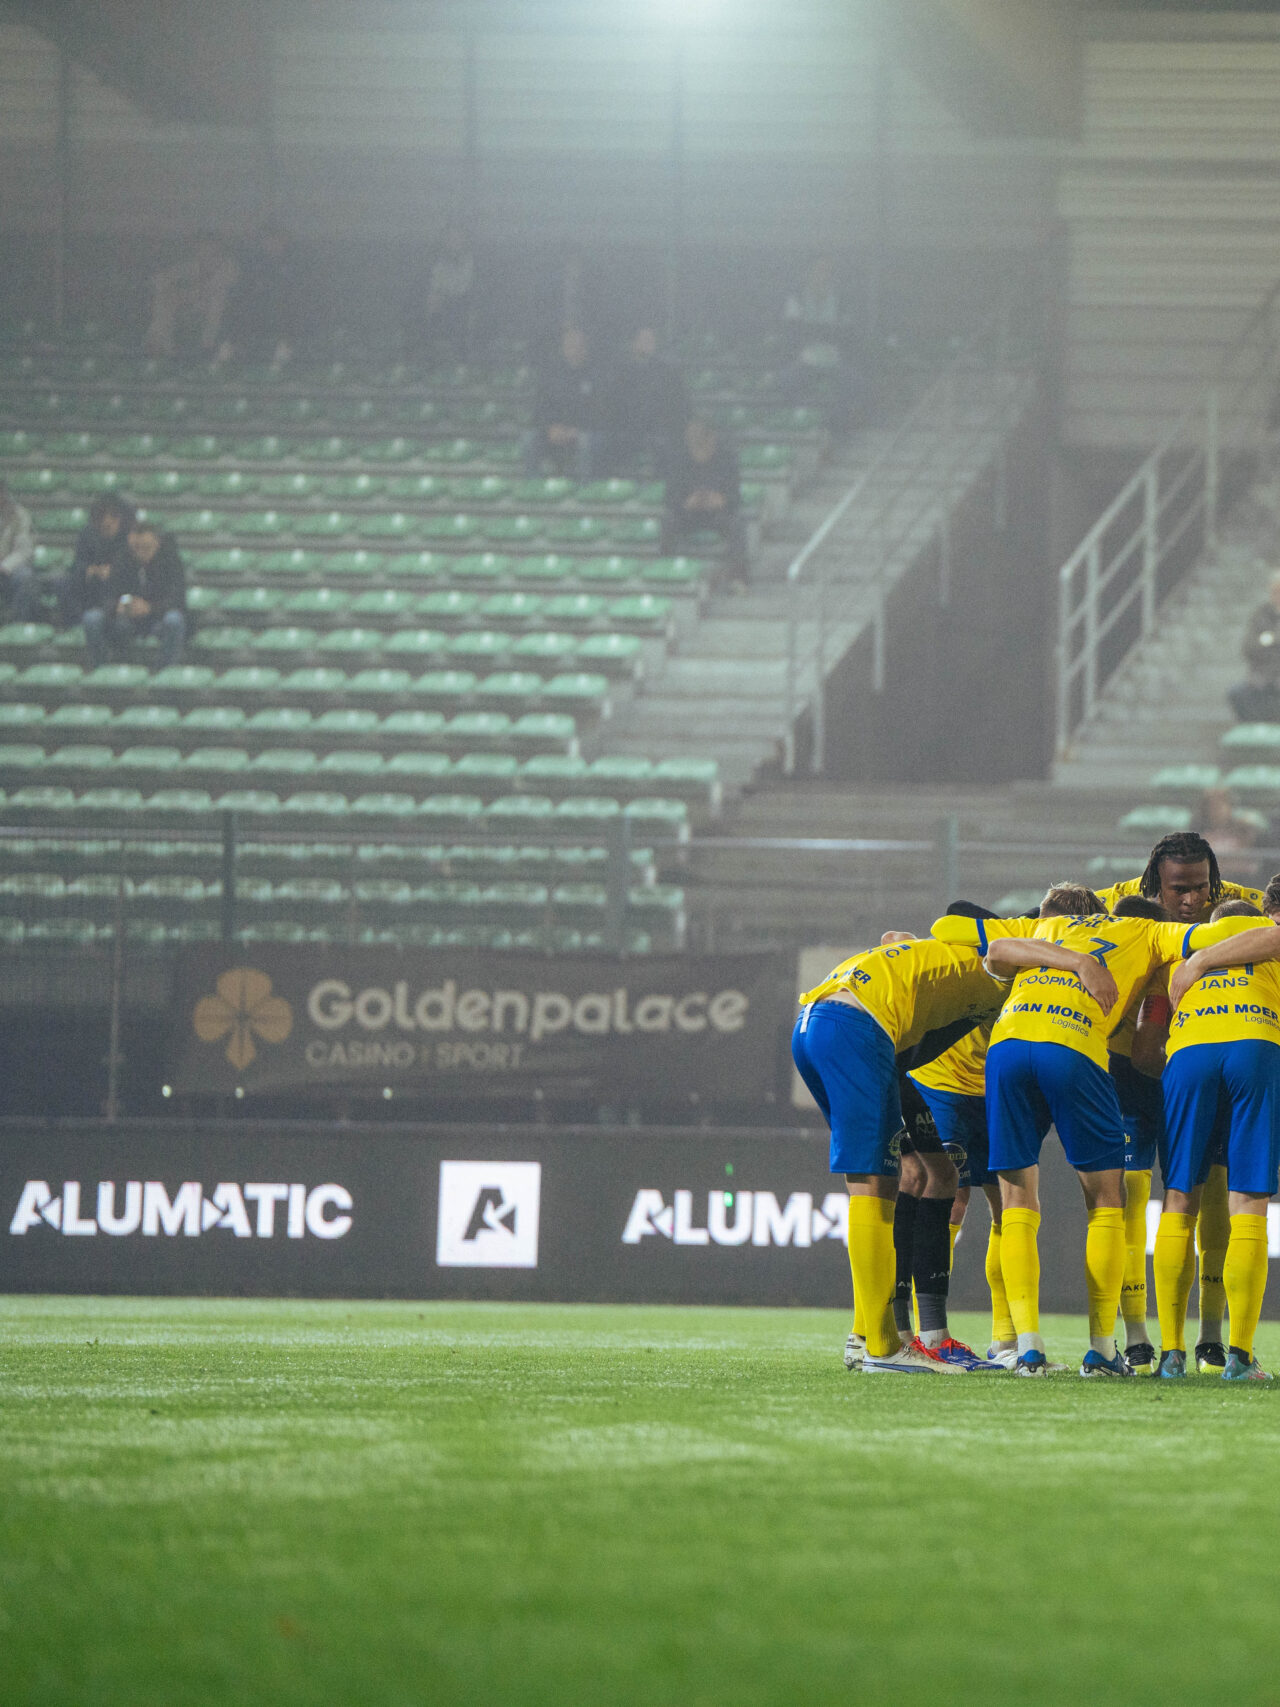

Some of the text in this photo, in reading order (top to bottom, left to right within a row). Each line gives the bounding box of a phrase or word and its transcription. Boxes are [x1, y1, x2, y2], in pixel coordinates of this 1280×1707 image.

[1199, 976, 1249, 991] JANS
[307, 979, 749, 1041] Goldenpalace
[1012, 1002, 1093, 1028] VAN MOER
[1194, 1003, 1279, 1023] VAN MOER
[1051, 1016, 1089, 1037] Logistics
[305, 1040, 524, 1070] CASINO SPORT
[10, 1181, 354, 1239] ALUMATIC
[622, 1189, 850, 1247] ALUMA
